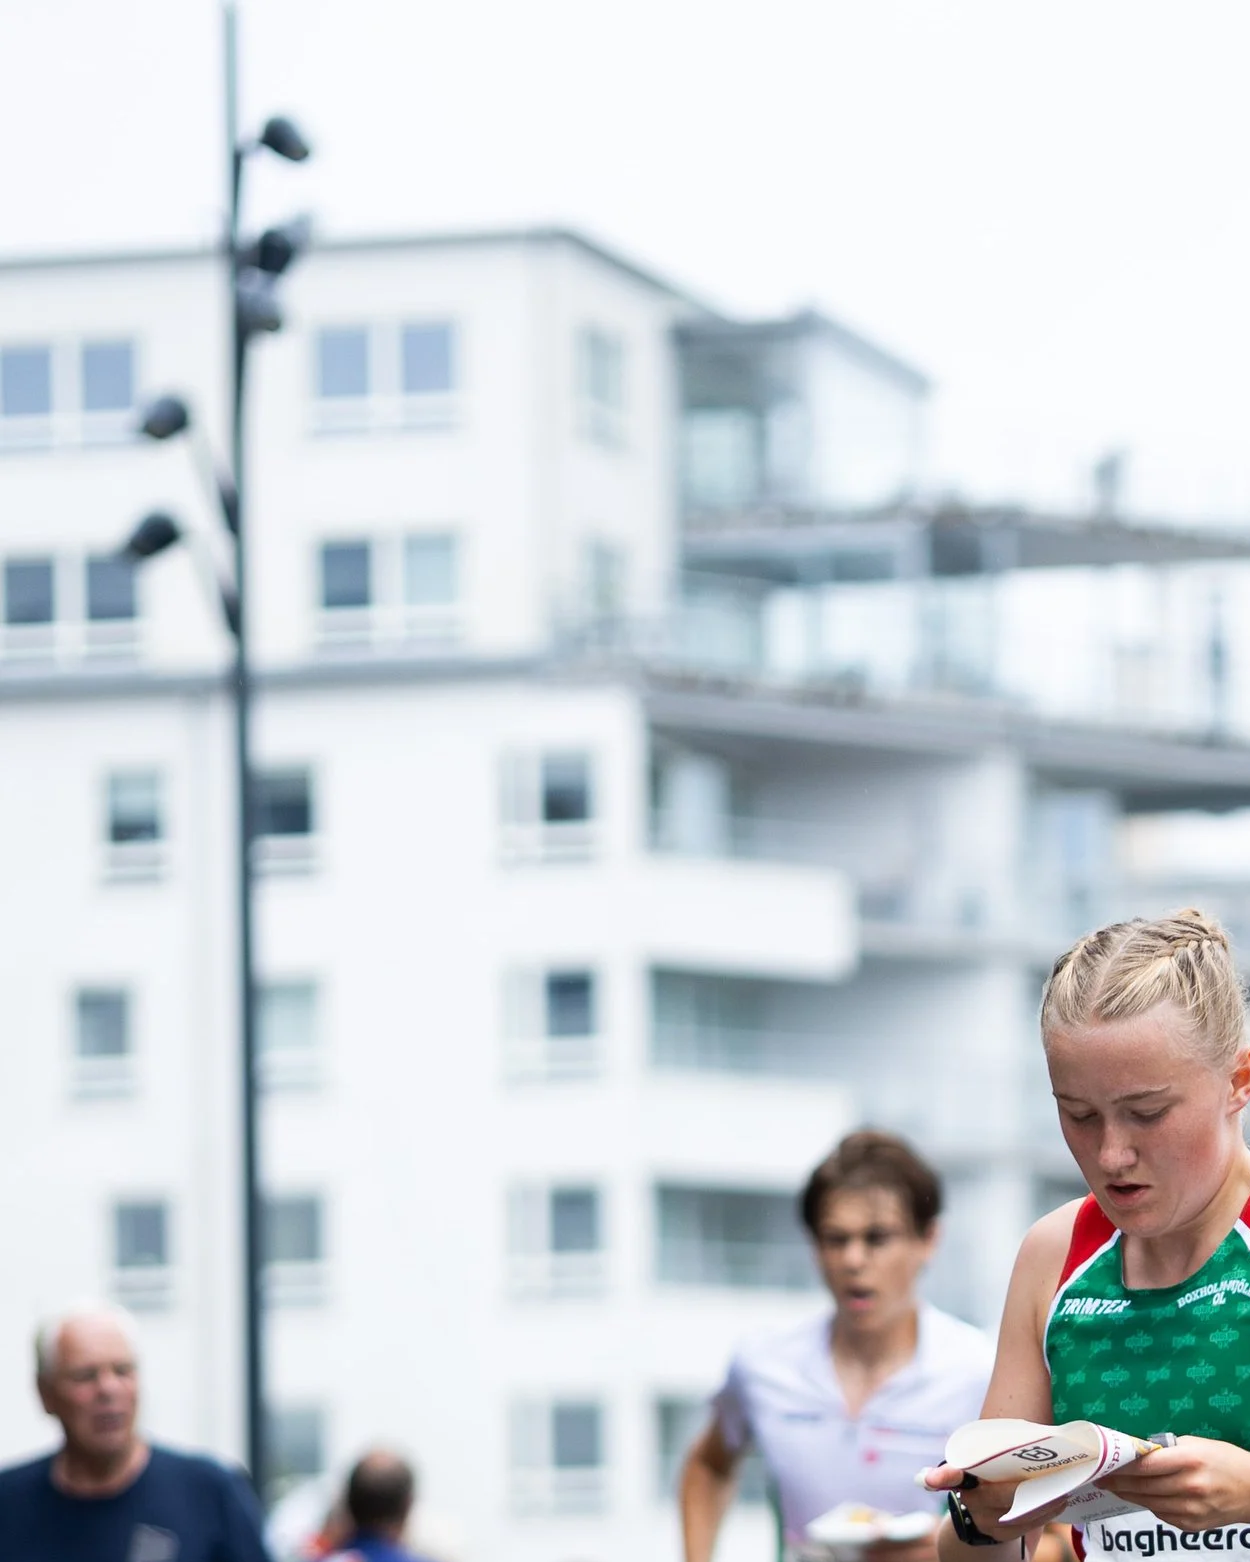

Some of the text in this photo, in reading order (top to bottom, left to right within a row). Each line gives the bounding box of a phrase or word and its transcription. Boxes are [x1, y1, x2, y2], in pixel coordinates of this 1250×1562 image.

[1060, 1297, 1132, 1315] TRIMTEX
[1212, 1291, 1227, 1306] OL
[1022, 1452, 1089, 1474] Husqvarna
